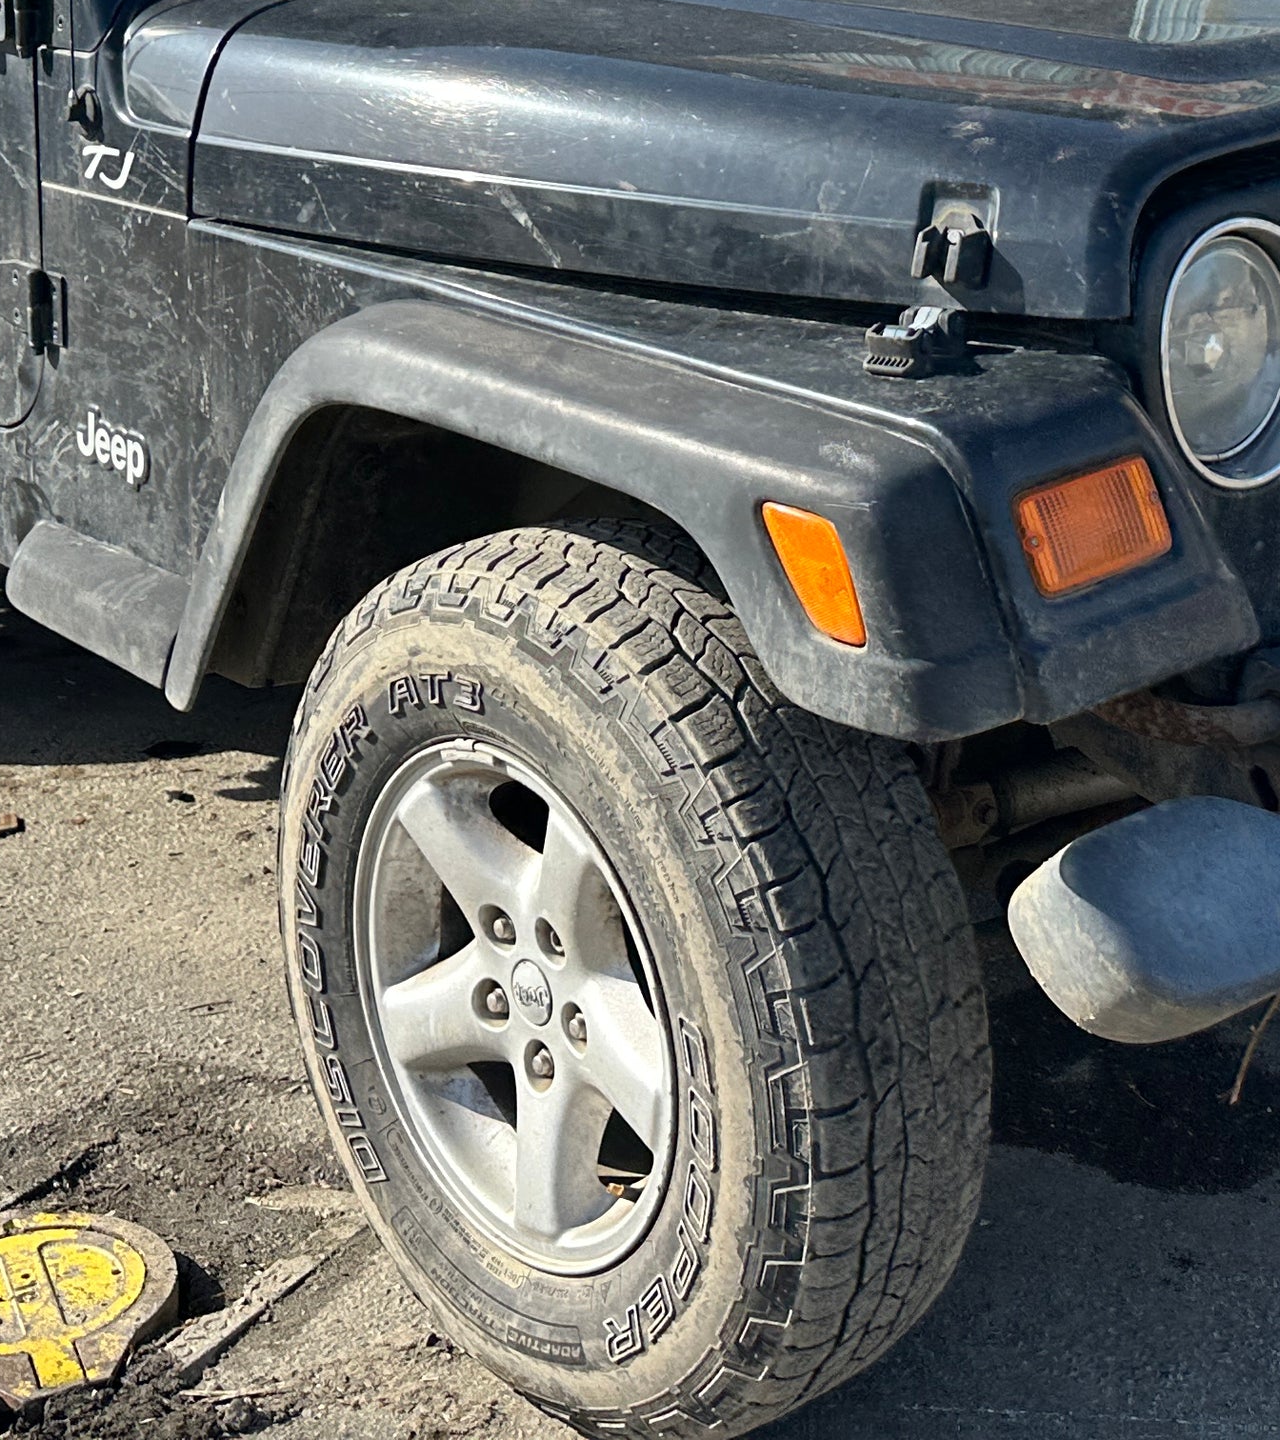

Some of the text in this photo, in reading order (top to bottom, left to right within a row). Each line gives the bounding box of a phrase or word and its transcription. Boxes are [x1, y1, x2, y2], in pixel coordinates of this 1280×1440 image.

[81, 145, 135, 190] TJ
[75, 410, 146, 486] Jeep
[296, 702, 390, 1184] DISCOVERER
[387, 670, 486, 716] AT3
[605, 1015, 718, 1365] COOPER
